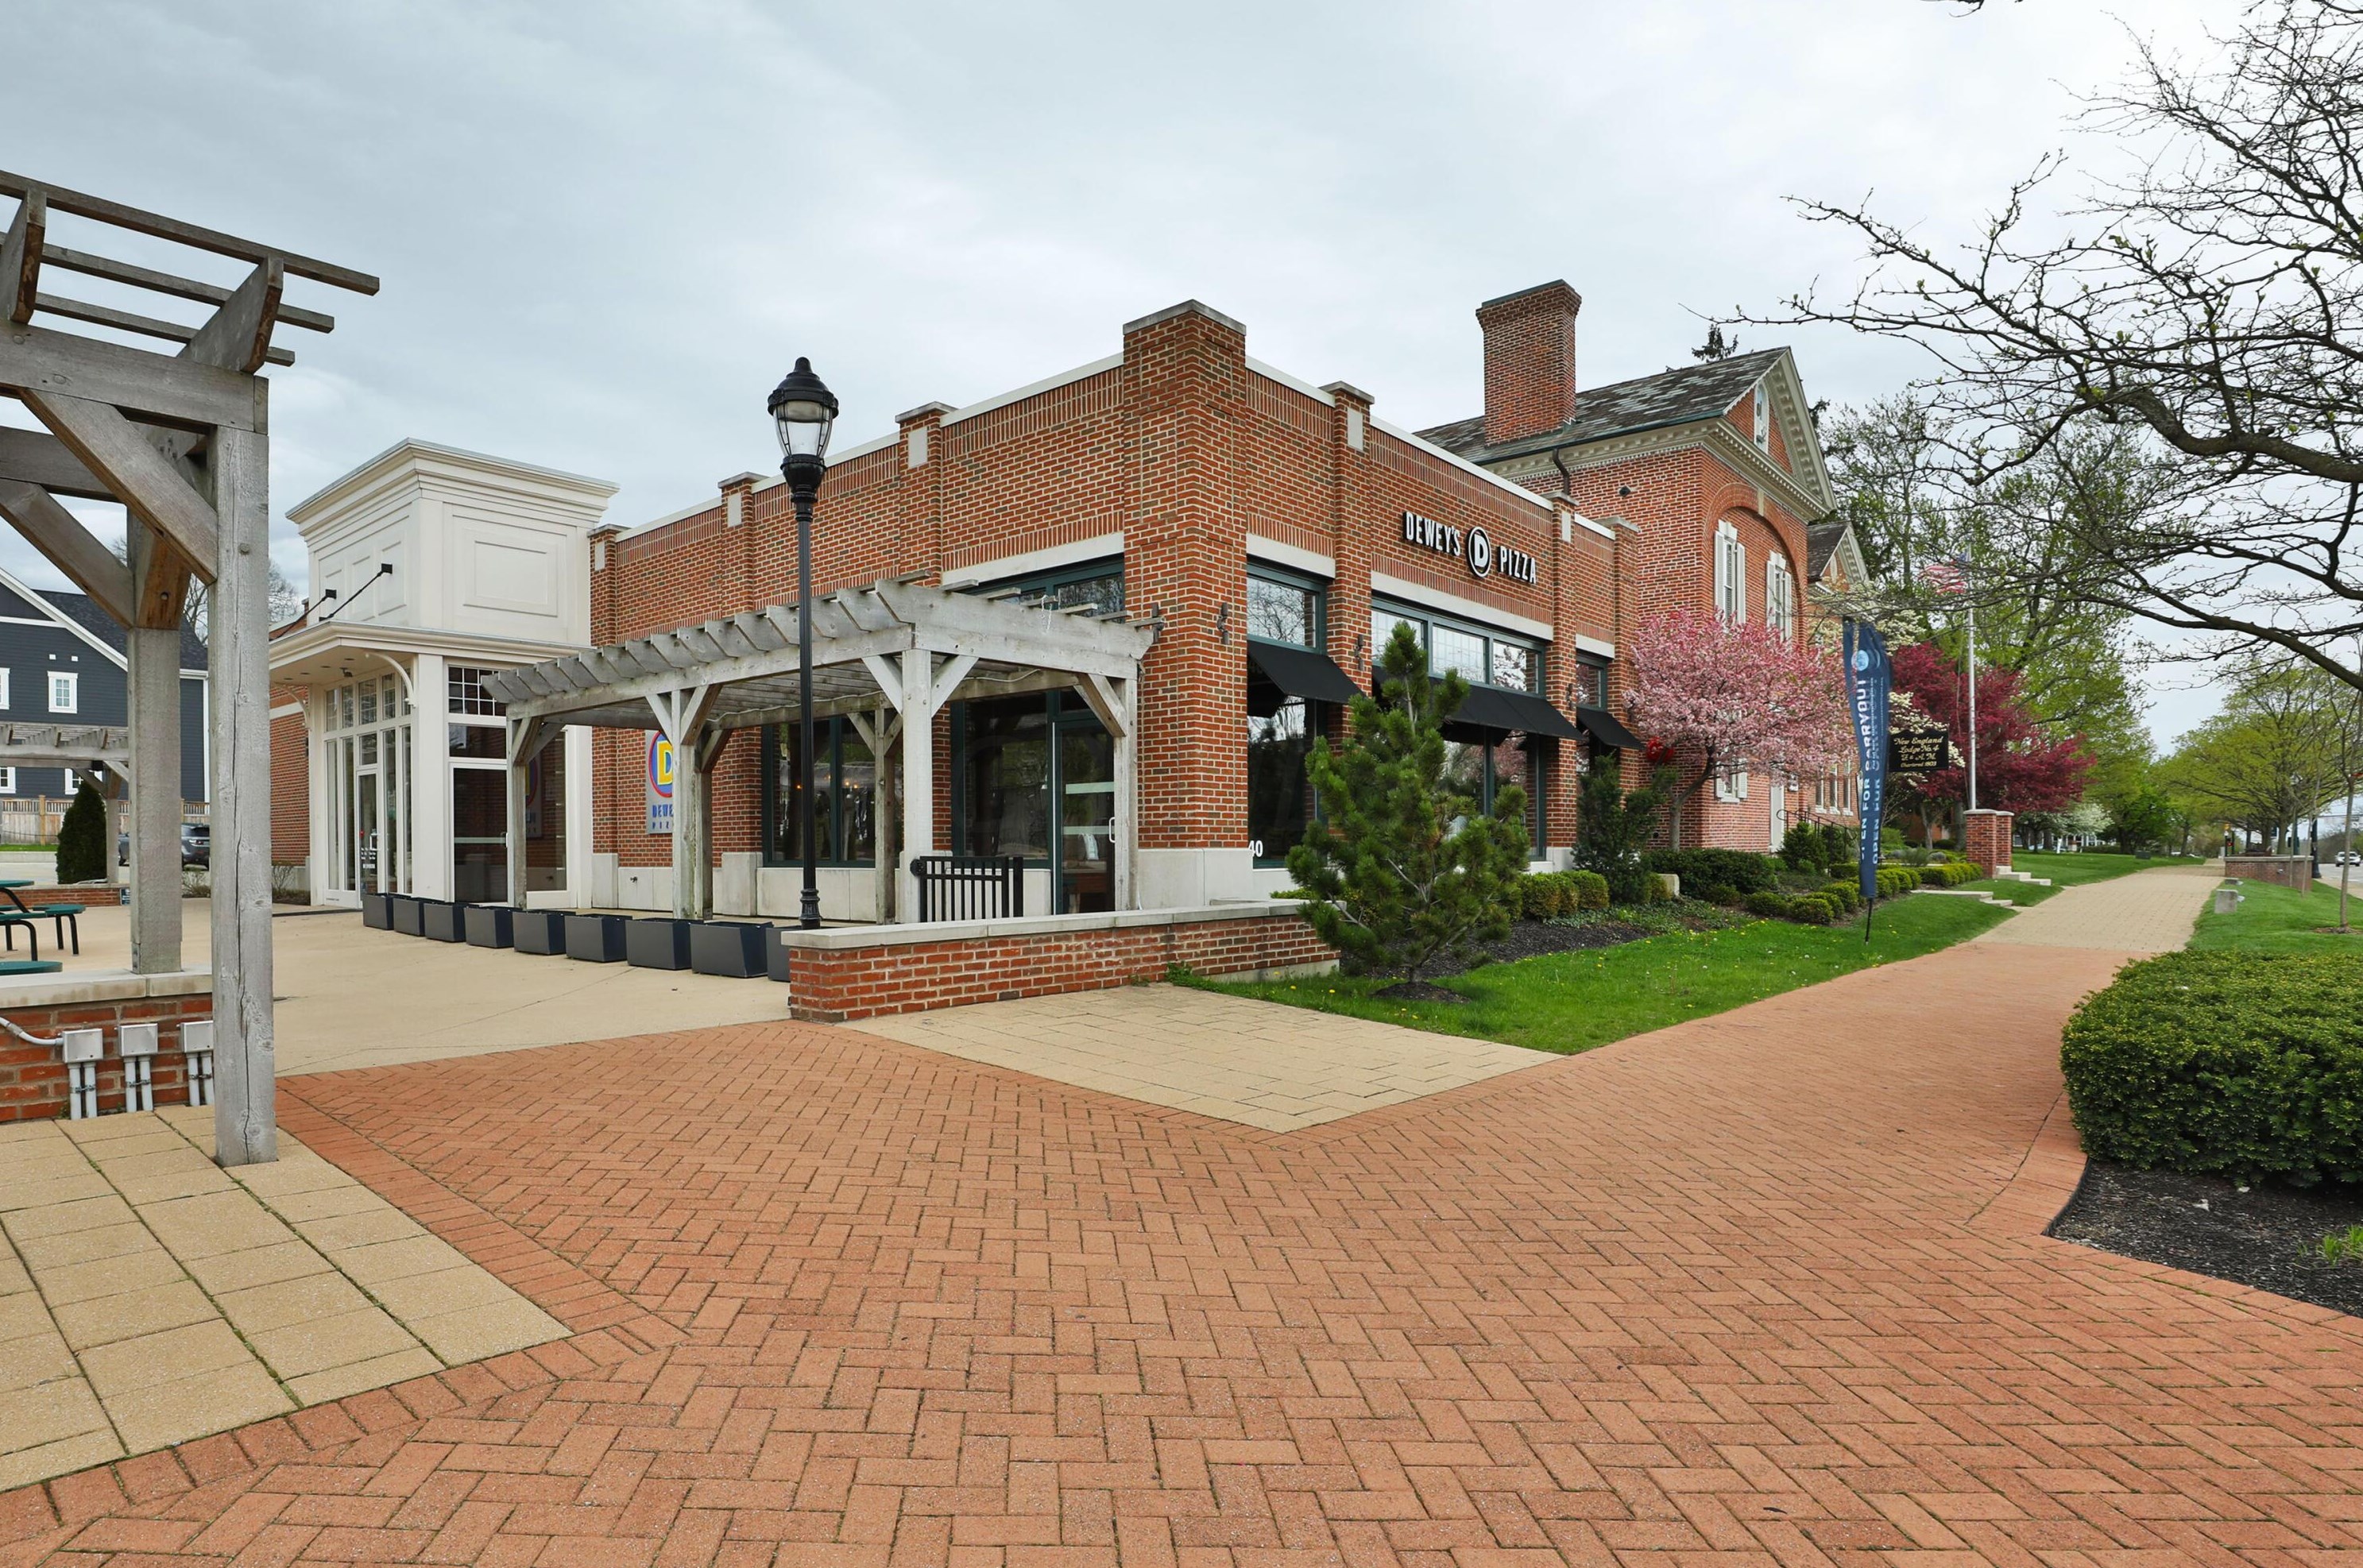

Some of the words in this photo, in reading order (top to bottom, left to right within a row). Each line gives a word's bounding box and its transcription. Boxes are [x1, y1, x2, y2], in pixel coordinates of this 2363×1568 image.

[1404, 511, 1461, 557] DEWEY'S
[1499, 546, 1537, 585] PIZZA
[1911, 736, 1943, 747] England
[1898, 745, 1921, 755] Lodge
[652, 803, 674, 818] DEWE
[652, 821, 670, 829] PIZ
